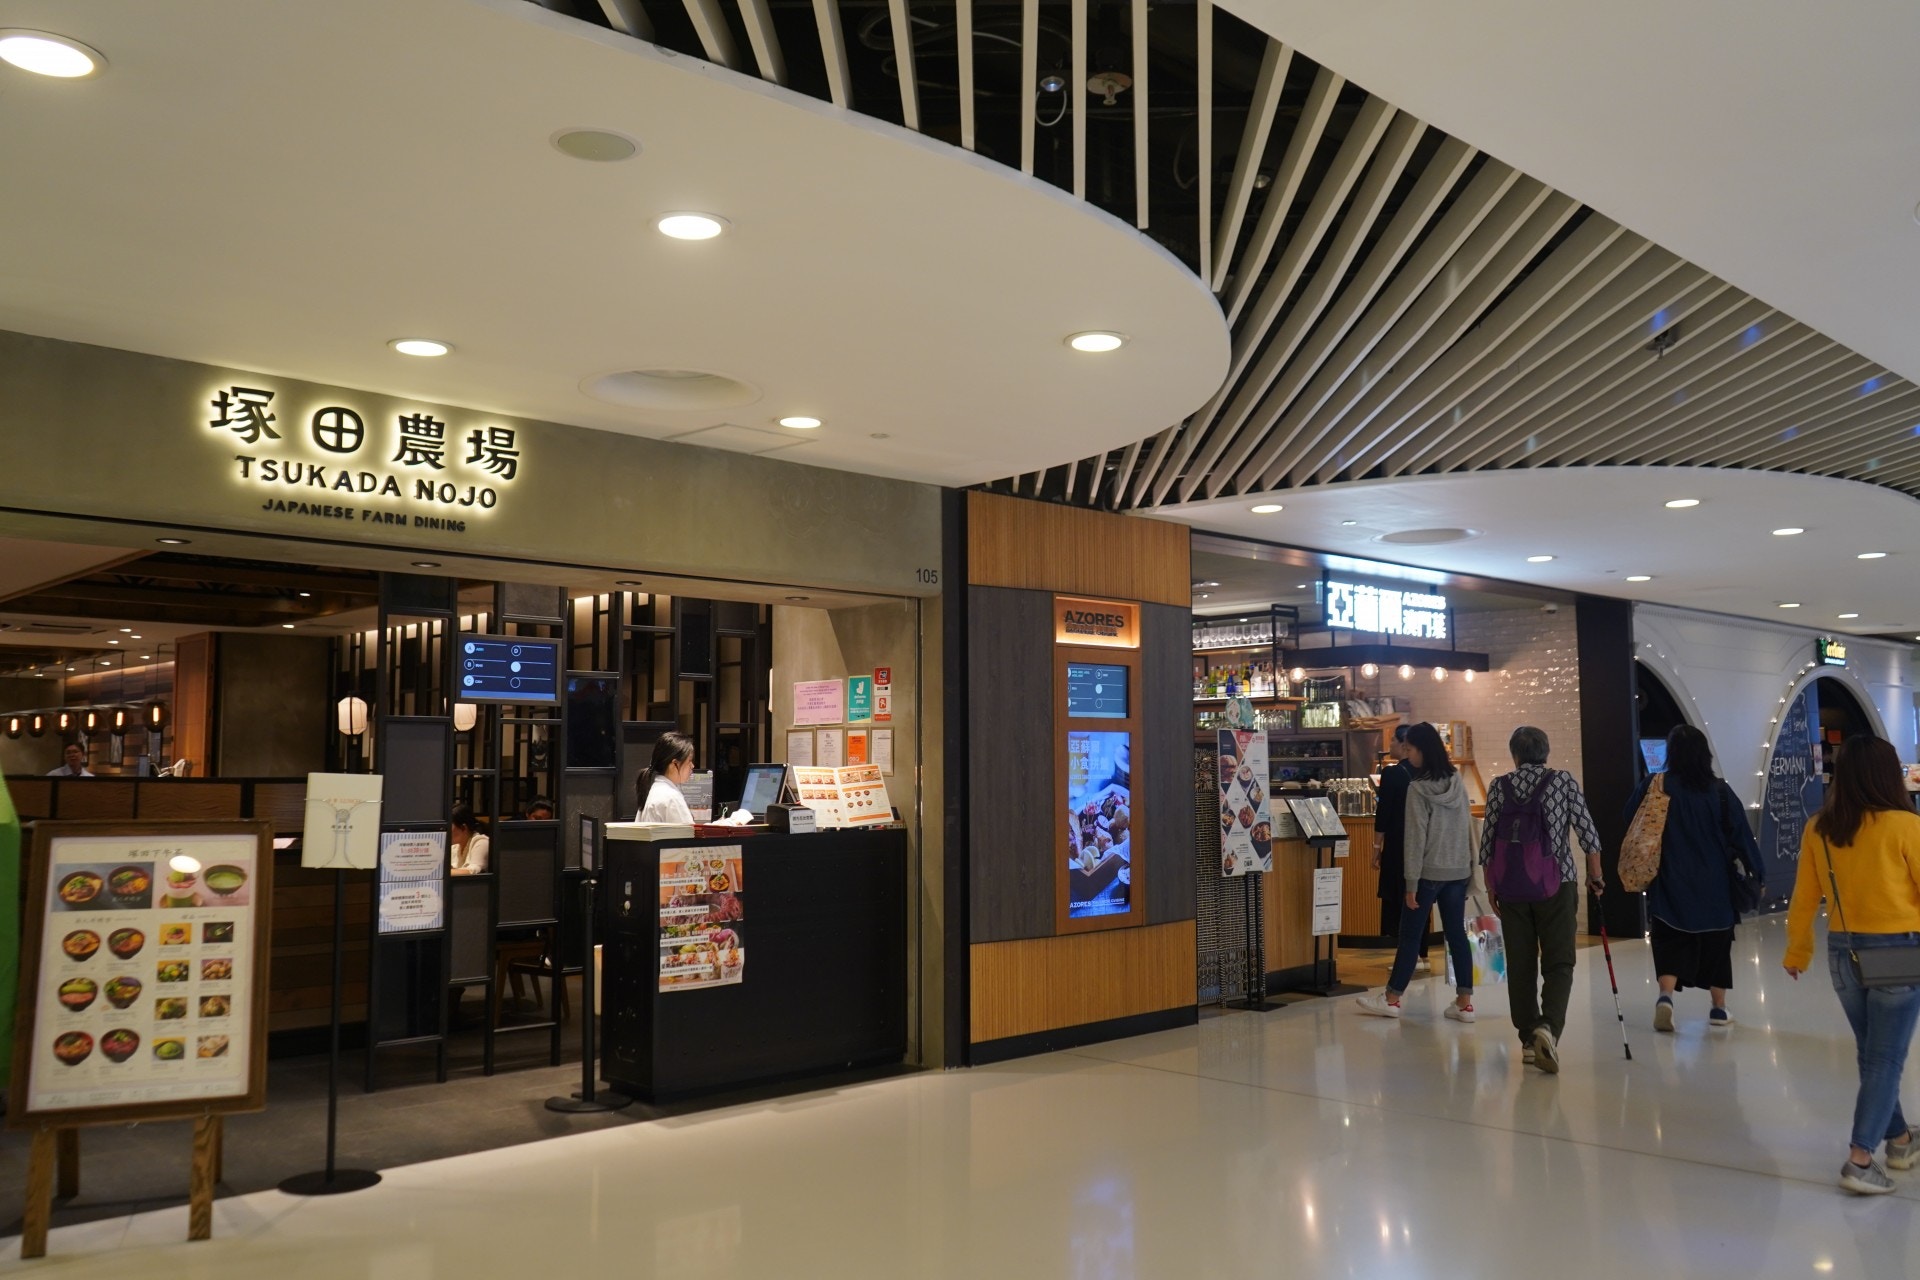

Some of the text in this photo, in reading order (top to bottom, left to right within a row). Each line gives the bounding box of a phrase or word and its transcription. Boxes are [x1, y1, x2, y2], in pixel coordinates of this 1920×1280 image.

[209, 385, 520, 481] 塚田農場
[235, 454, 498, 509] TSUKADA NOJO
[262, 498, 466, 533] JAPANESE FARM DINING
[916, 568, 938, 584] 105
[1065, 610, 1124, 628] AZORES
[1769, 756, 1806, 778] GERMANY
